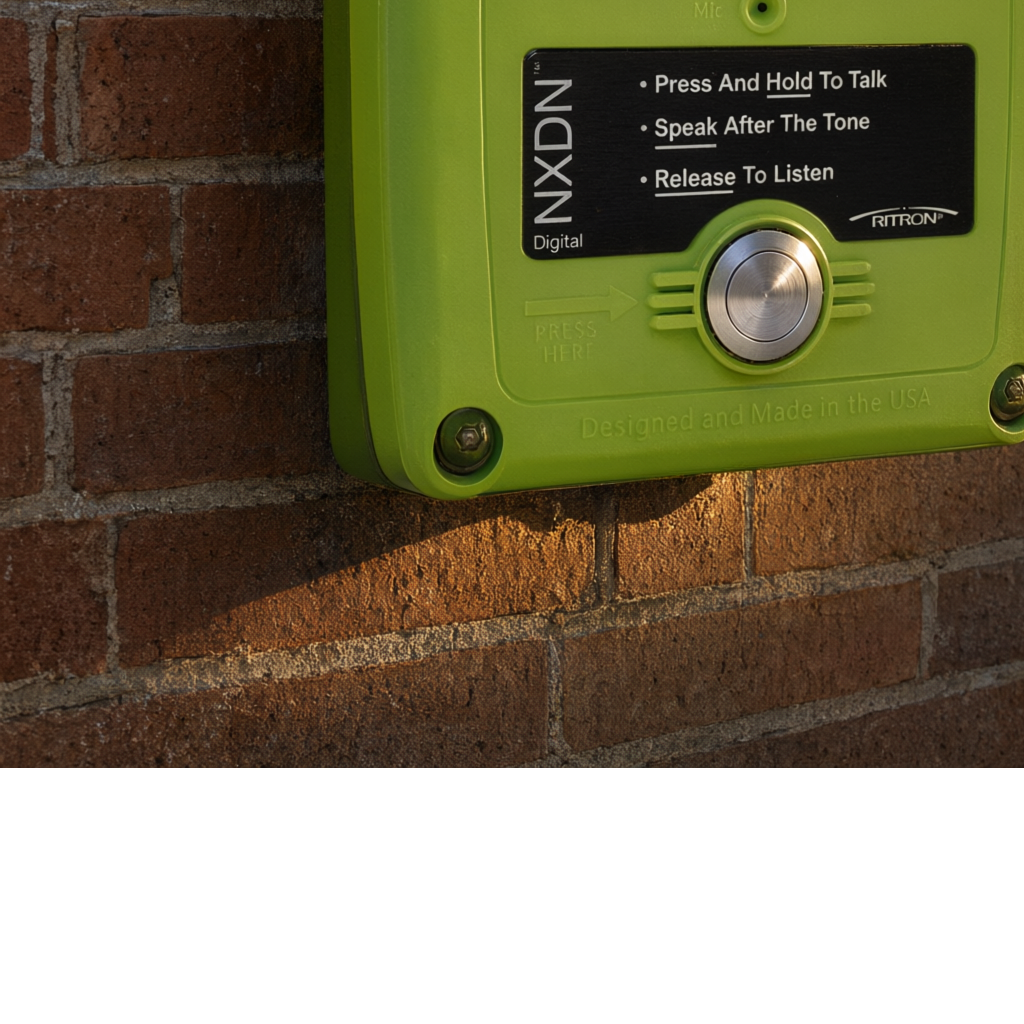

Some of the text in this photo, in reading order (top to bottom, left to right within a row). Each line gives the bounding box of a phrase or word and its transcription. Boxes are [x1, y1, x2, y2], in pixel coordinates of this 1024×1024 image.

[655, 69, 888, 93] Press And Hold To Talk
[654, 112, 871, 142] Speak After The Tone
[533, 79, 573, 224] NXDN
[654, 163, 834, 189] Release To Listen
[533, 233, 583, 253] Digital
[535, 320, 597, 343] PRESS
[581, 386, 931, 442] Designed and Made in the USA
